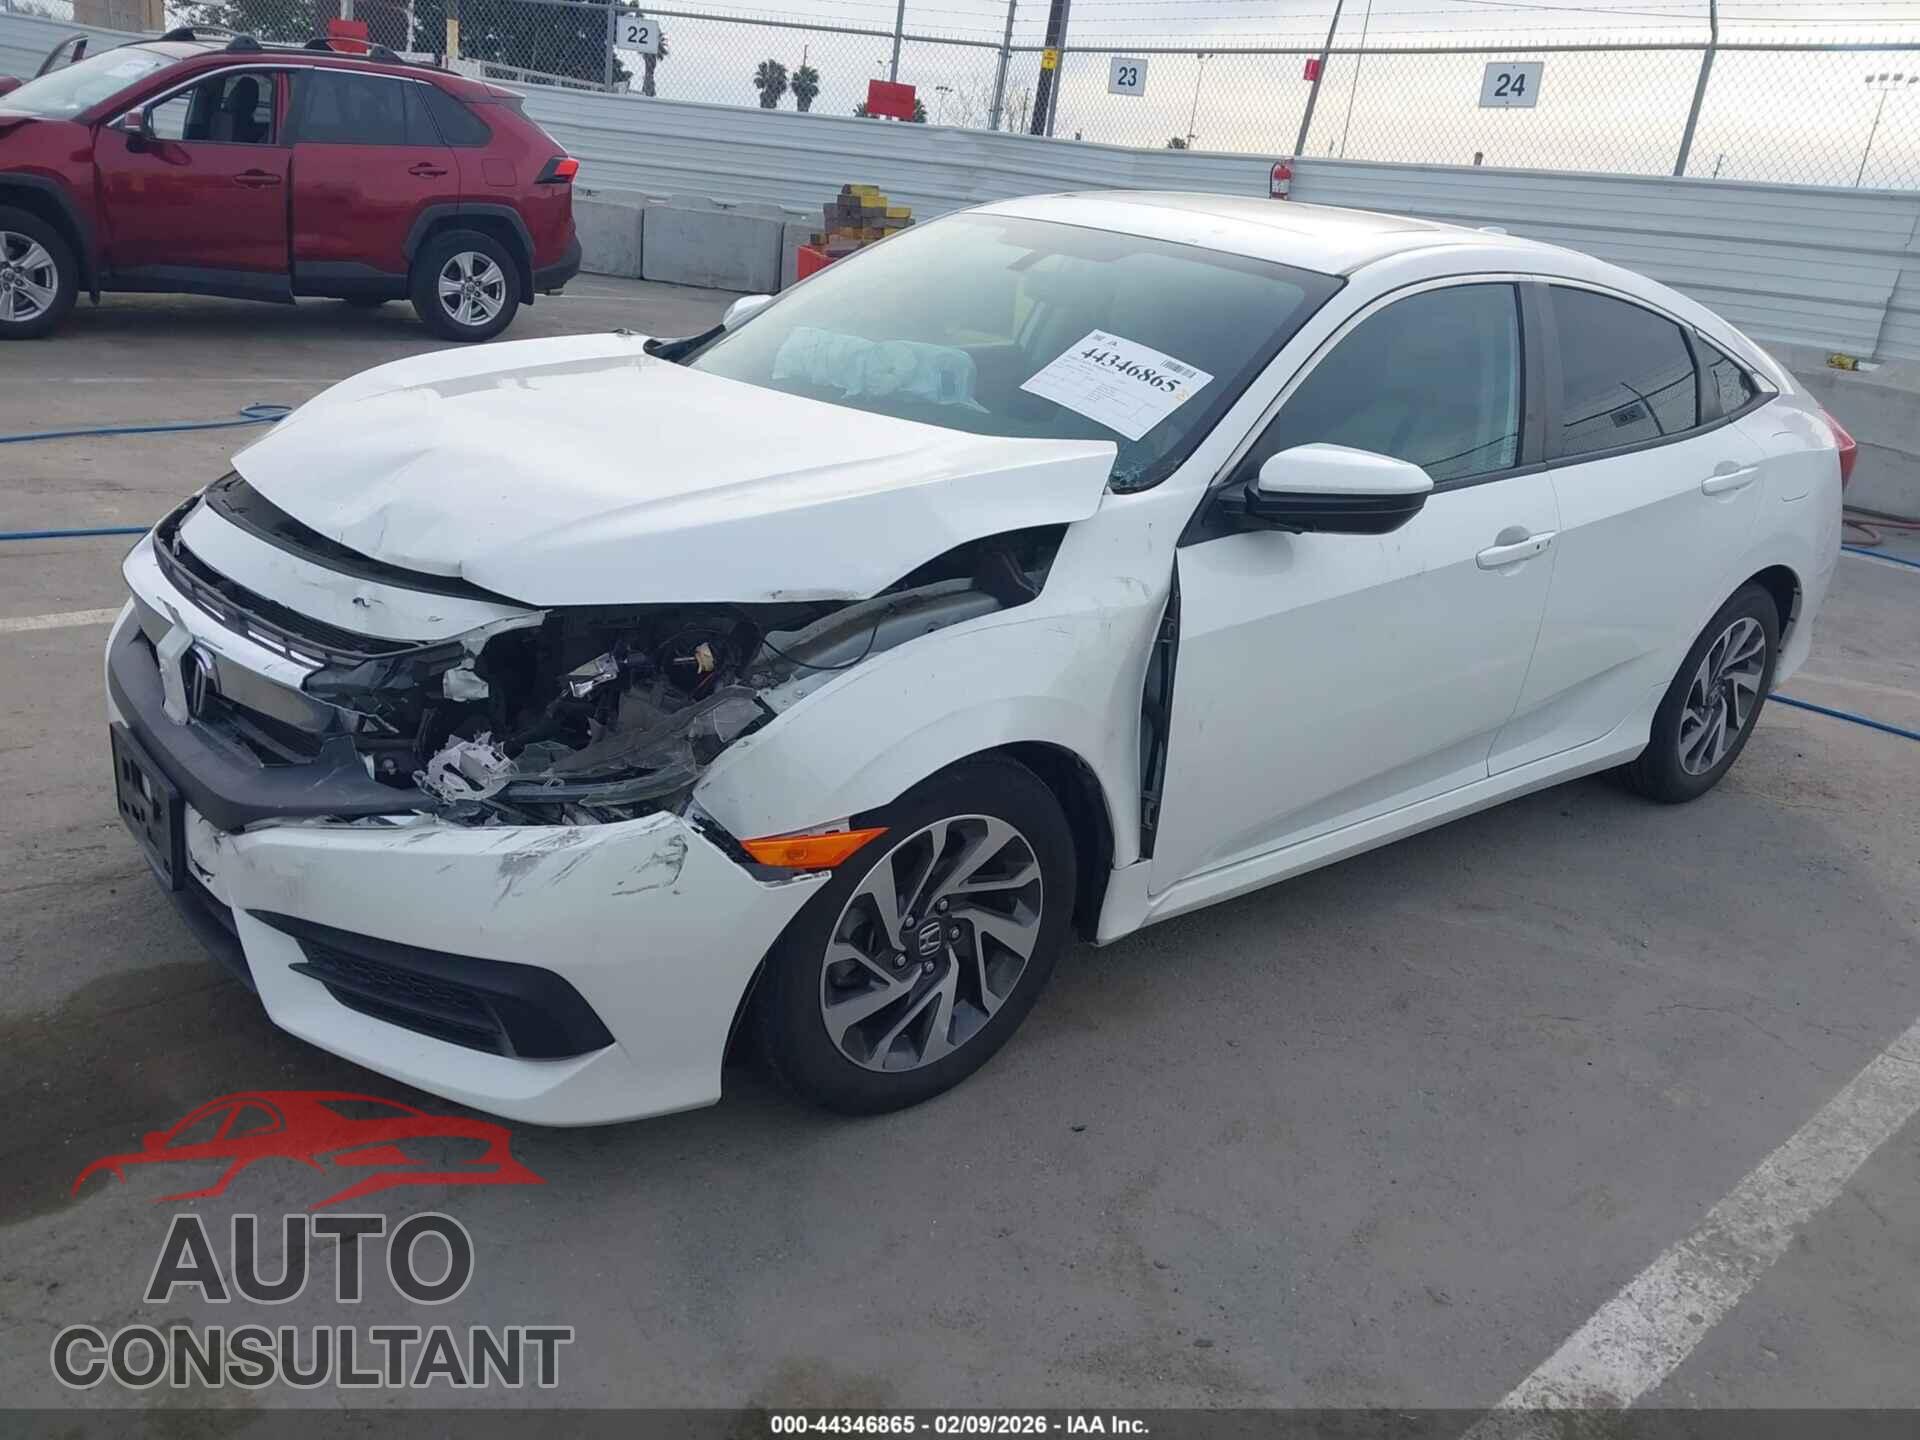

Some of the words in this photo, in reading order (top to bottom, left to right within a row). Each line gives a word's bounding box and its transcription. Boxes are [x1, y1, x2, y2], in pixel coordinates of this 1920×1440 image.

[628, 26, 649, 44] 22
[1118, 66, 1138, 87] 23
[1494, 73, 1526, 97] 24
[1081, 348, 1181, 393] 44346865
